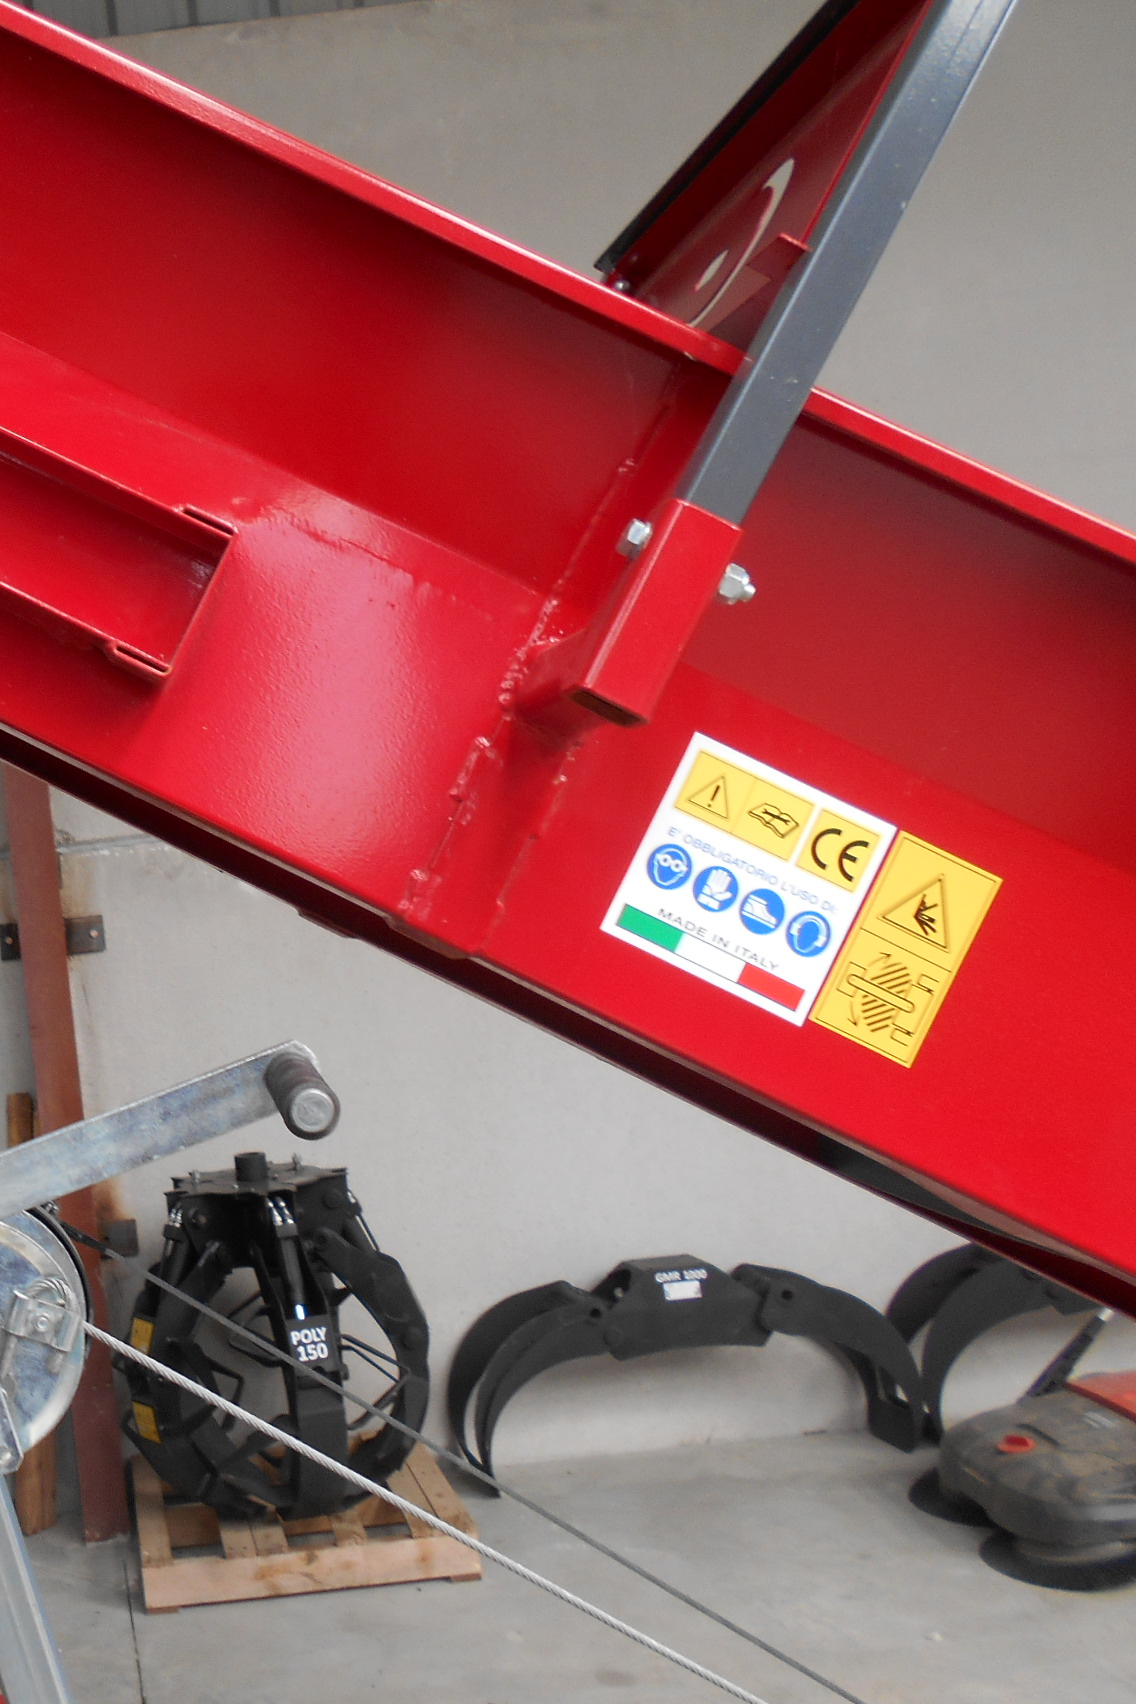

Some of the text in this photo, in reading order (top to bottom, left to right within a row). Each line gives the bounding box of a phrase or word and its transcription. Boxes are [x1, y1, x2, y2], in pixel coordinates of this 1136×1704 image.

[683, 834, 778, 885] OBBLIGATORIO
[781, 881, 818, 904] L'USO
[811, 828, 869, 882] CE
[658, 908, 779, 971] MADE IN ITALY
[654, 1270, 682, 1283] GMR
[290, 1326, 327, 1346] POLY
[297, 1343, 329, 1362] 150
